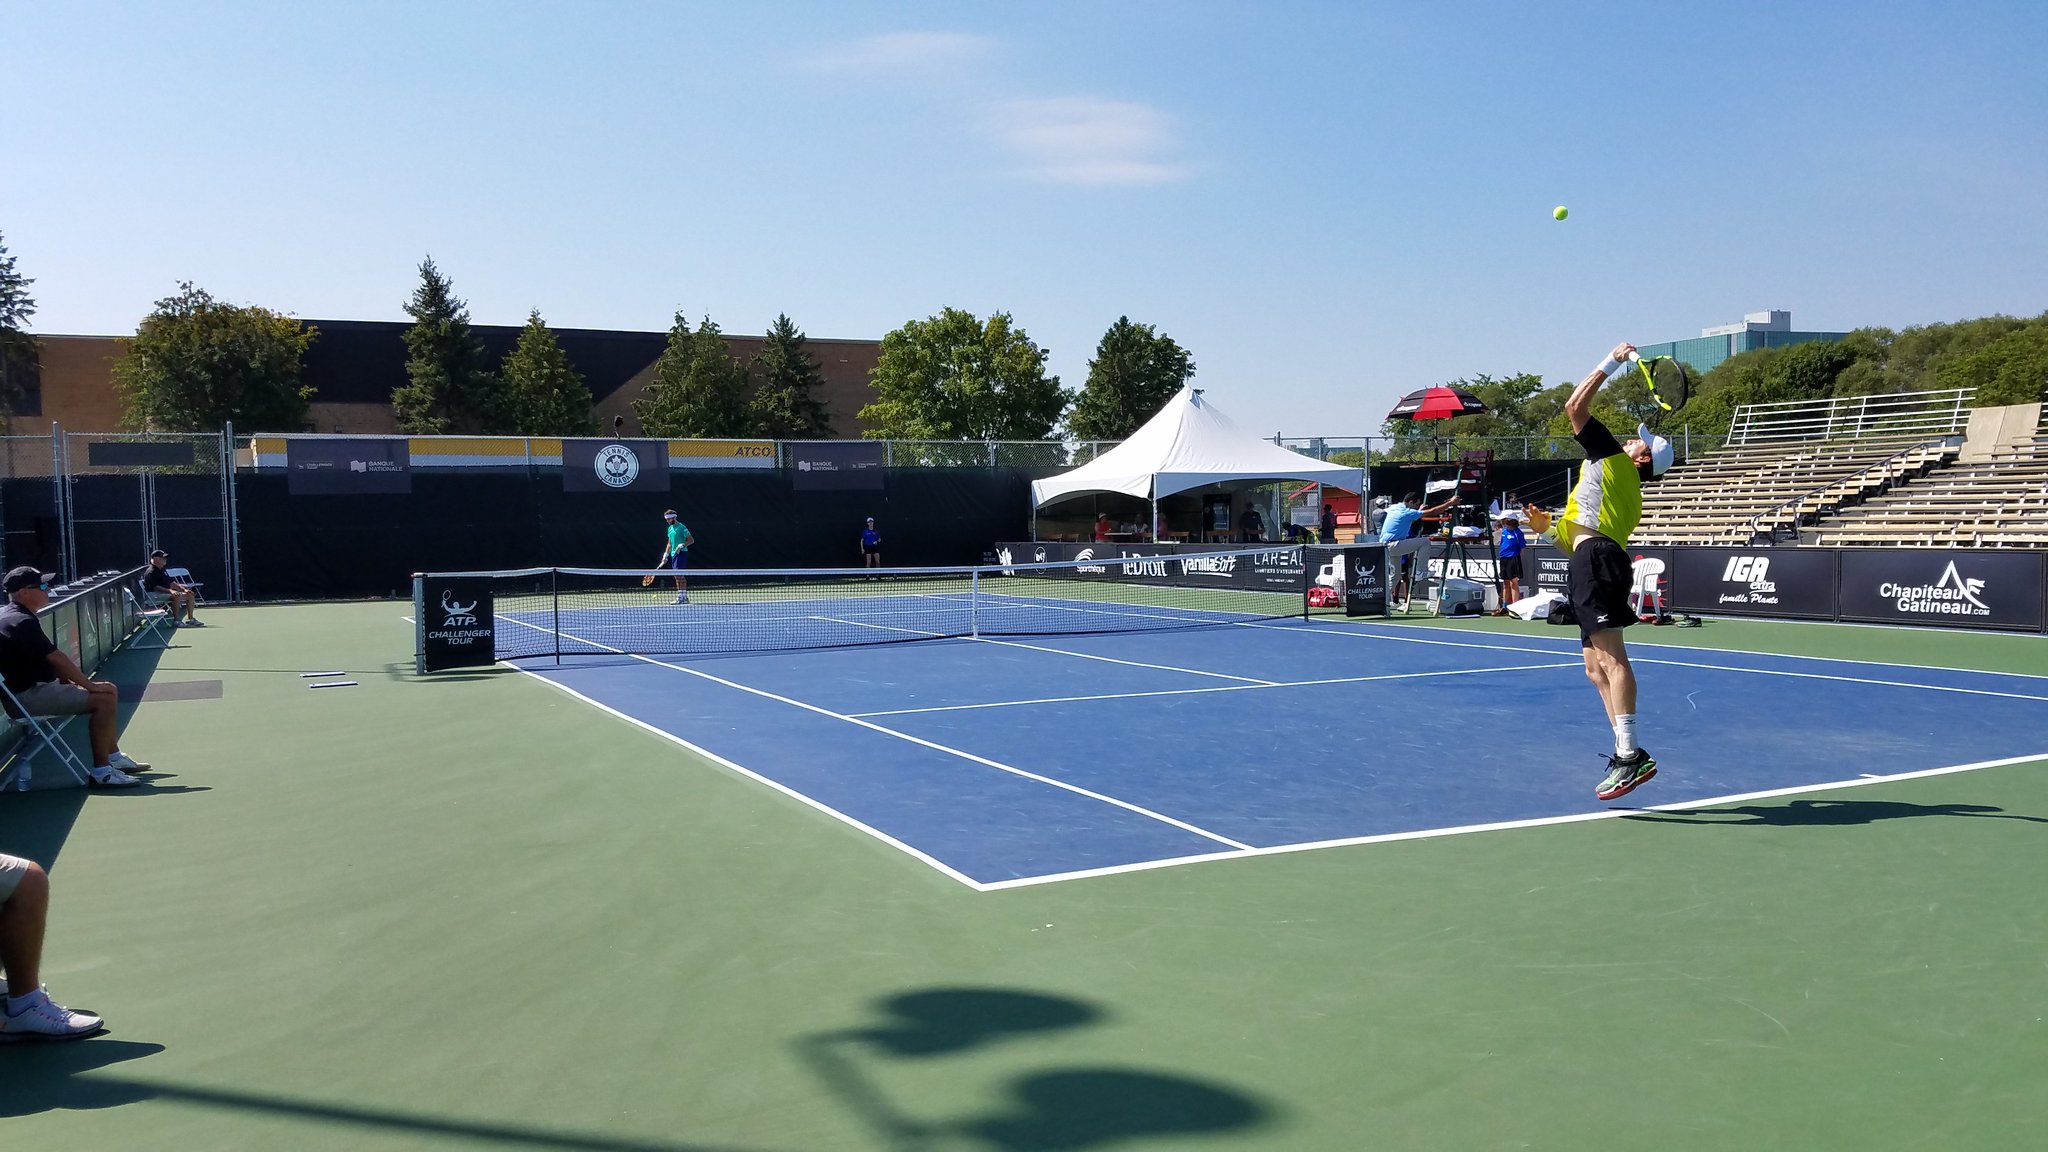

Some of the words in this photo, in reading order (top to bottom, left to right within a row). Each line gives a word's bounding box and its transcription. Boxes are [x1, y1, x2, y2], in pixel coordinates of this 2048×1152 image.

[603, 448, 630, 457] TENNIS
[735, 447, 771, 457] ATCO
[604, 475, 631, 484] CANADA
[1181, 556, 1236, 576] VanillaSoft
[1541, 561, 1569, 571] CHALLENGE
[1722, 556, 1770, 582] IGA
[1356, 577, 1376, 586] ATP
[1750, 580, 1776, 590] extra
[1347, 587, 1384, 595] CHALLENGER
[1880, 582, 1965, 601] Chapiteau
[1719, 593, 1748, 604] famille
[1750, 593, 1779, 604] Plante
[1897, 598, 1972, 615] Gatineau
[443, 617, 477, 626] ATP
[428, 630, 491, 638] CHALLENGER
